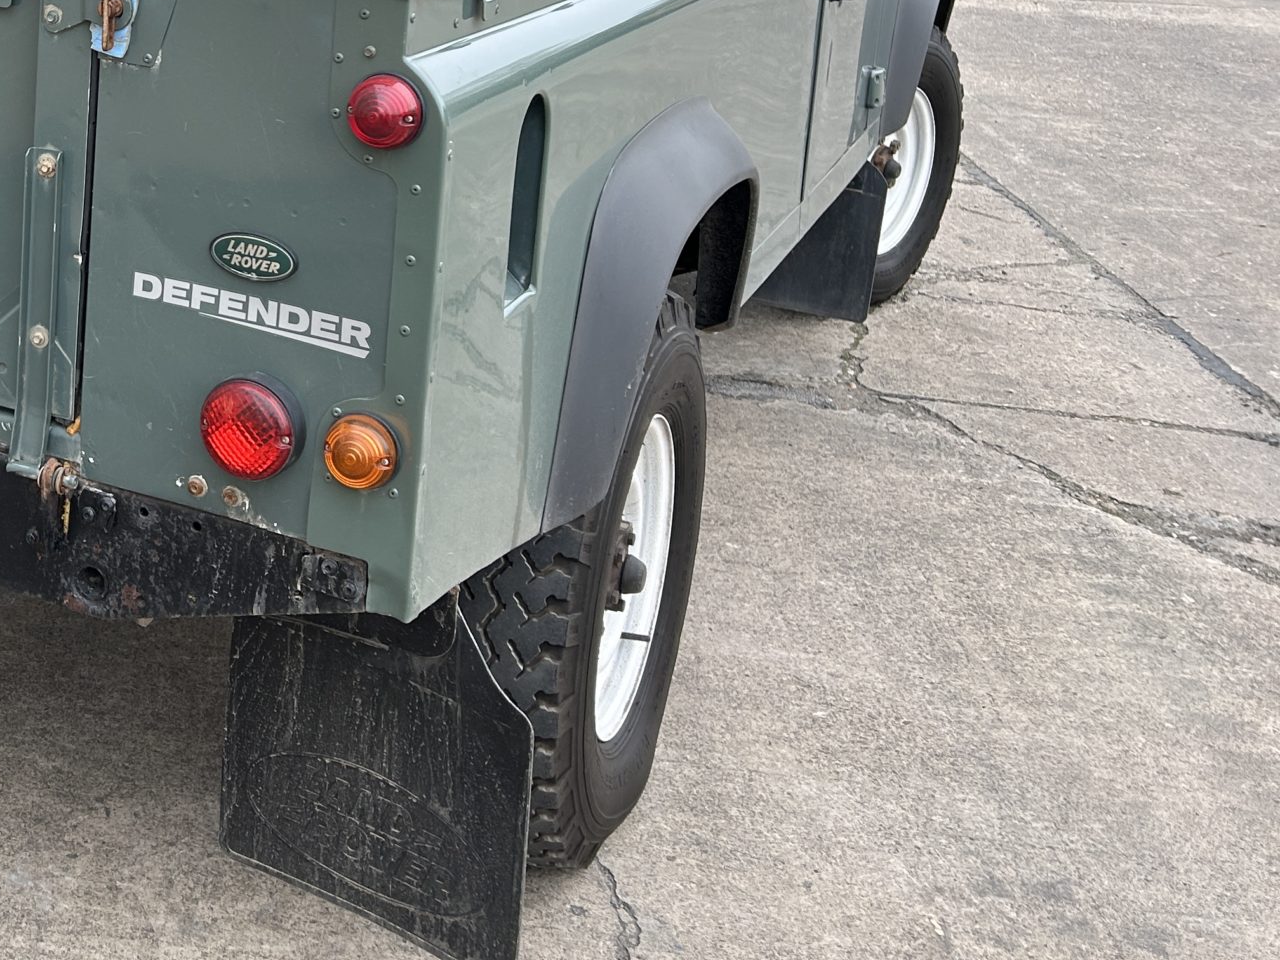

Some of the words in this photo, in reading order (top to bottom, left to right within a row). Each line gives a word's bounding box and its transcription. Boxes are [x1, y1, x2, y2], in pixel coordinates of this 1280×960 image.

[227, 239, 268, 259] LAND
[230, 254, 281, 275] ROVER
[133, 271, 372, 349] DEFENDER
